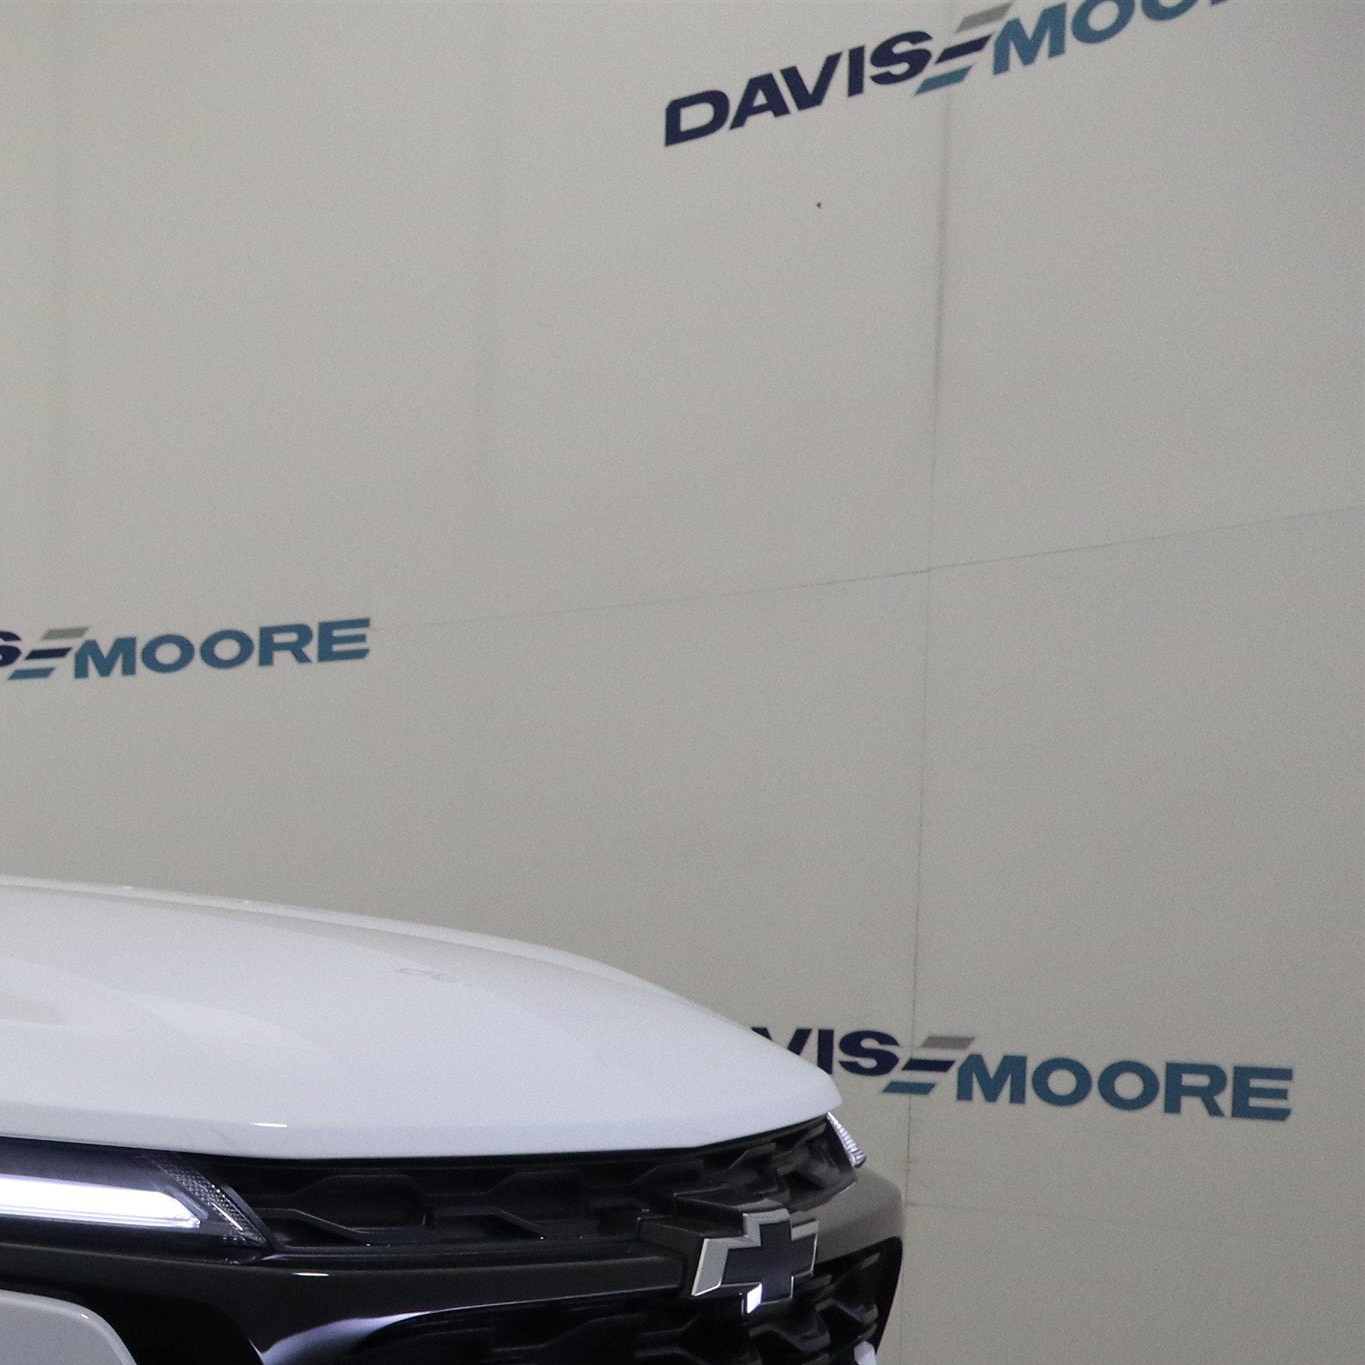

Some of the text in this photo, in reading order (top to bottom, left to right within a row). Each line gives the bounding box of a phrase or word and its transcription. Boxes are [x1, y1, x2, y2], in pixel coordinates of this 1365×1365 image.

[663, 0, 1228, 149] DAVIS MO
[73, 616, 372, 680] MOORE
[955, 1052, 1294, 1123] MOORE
